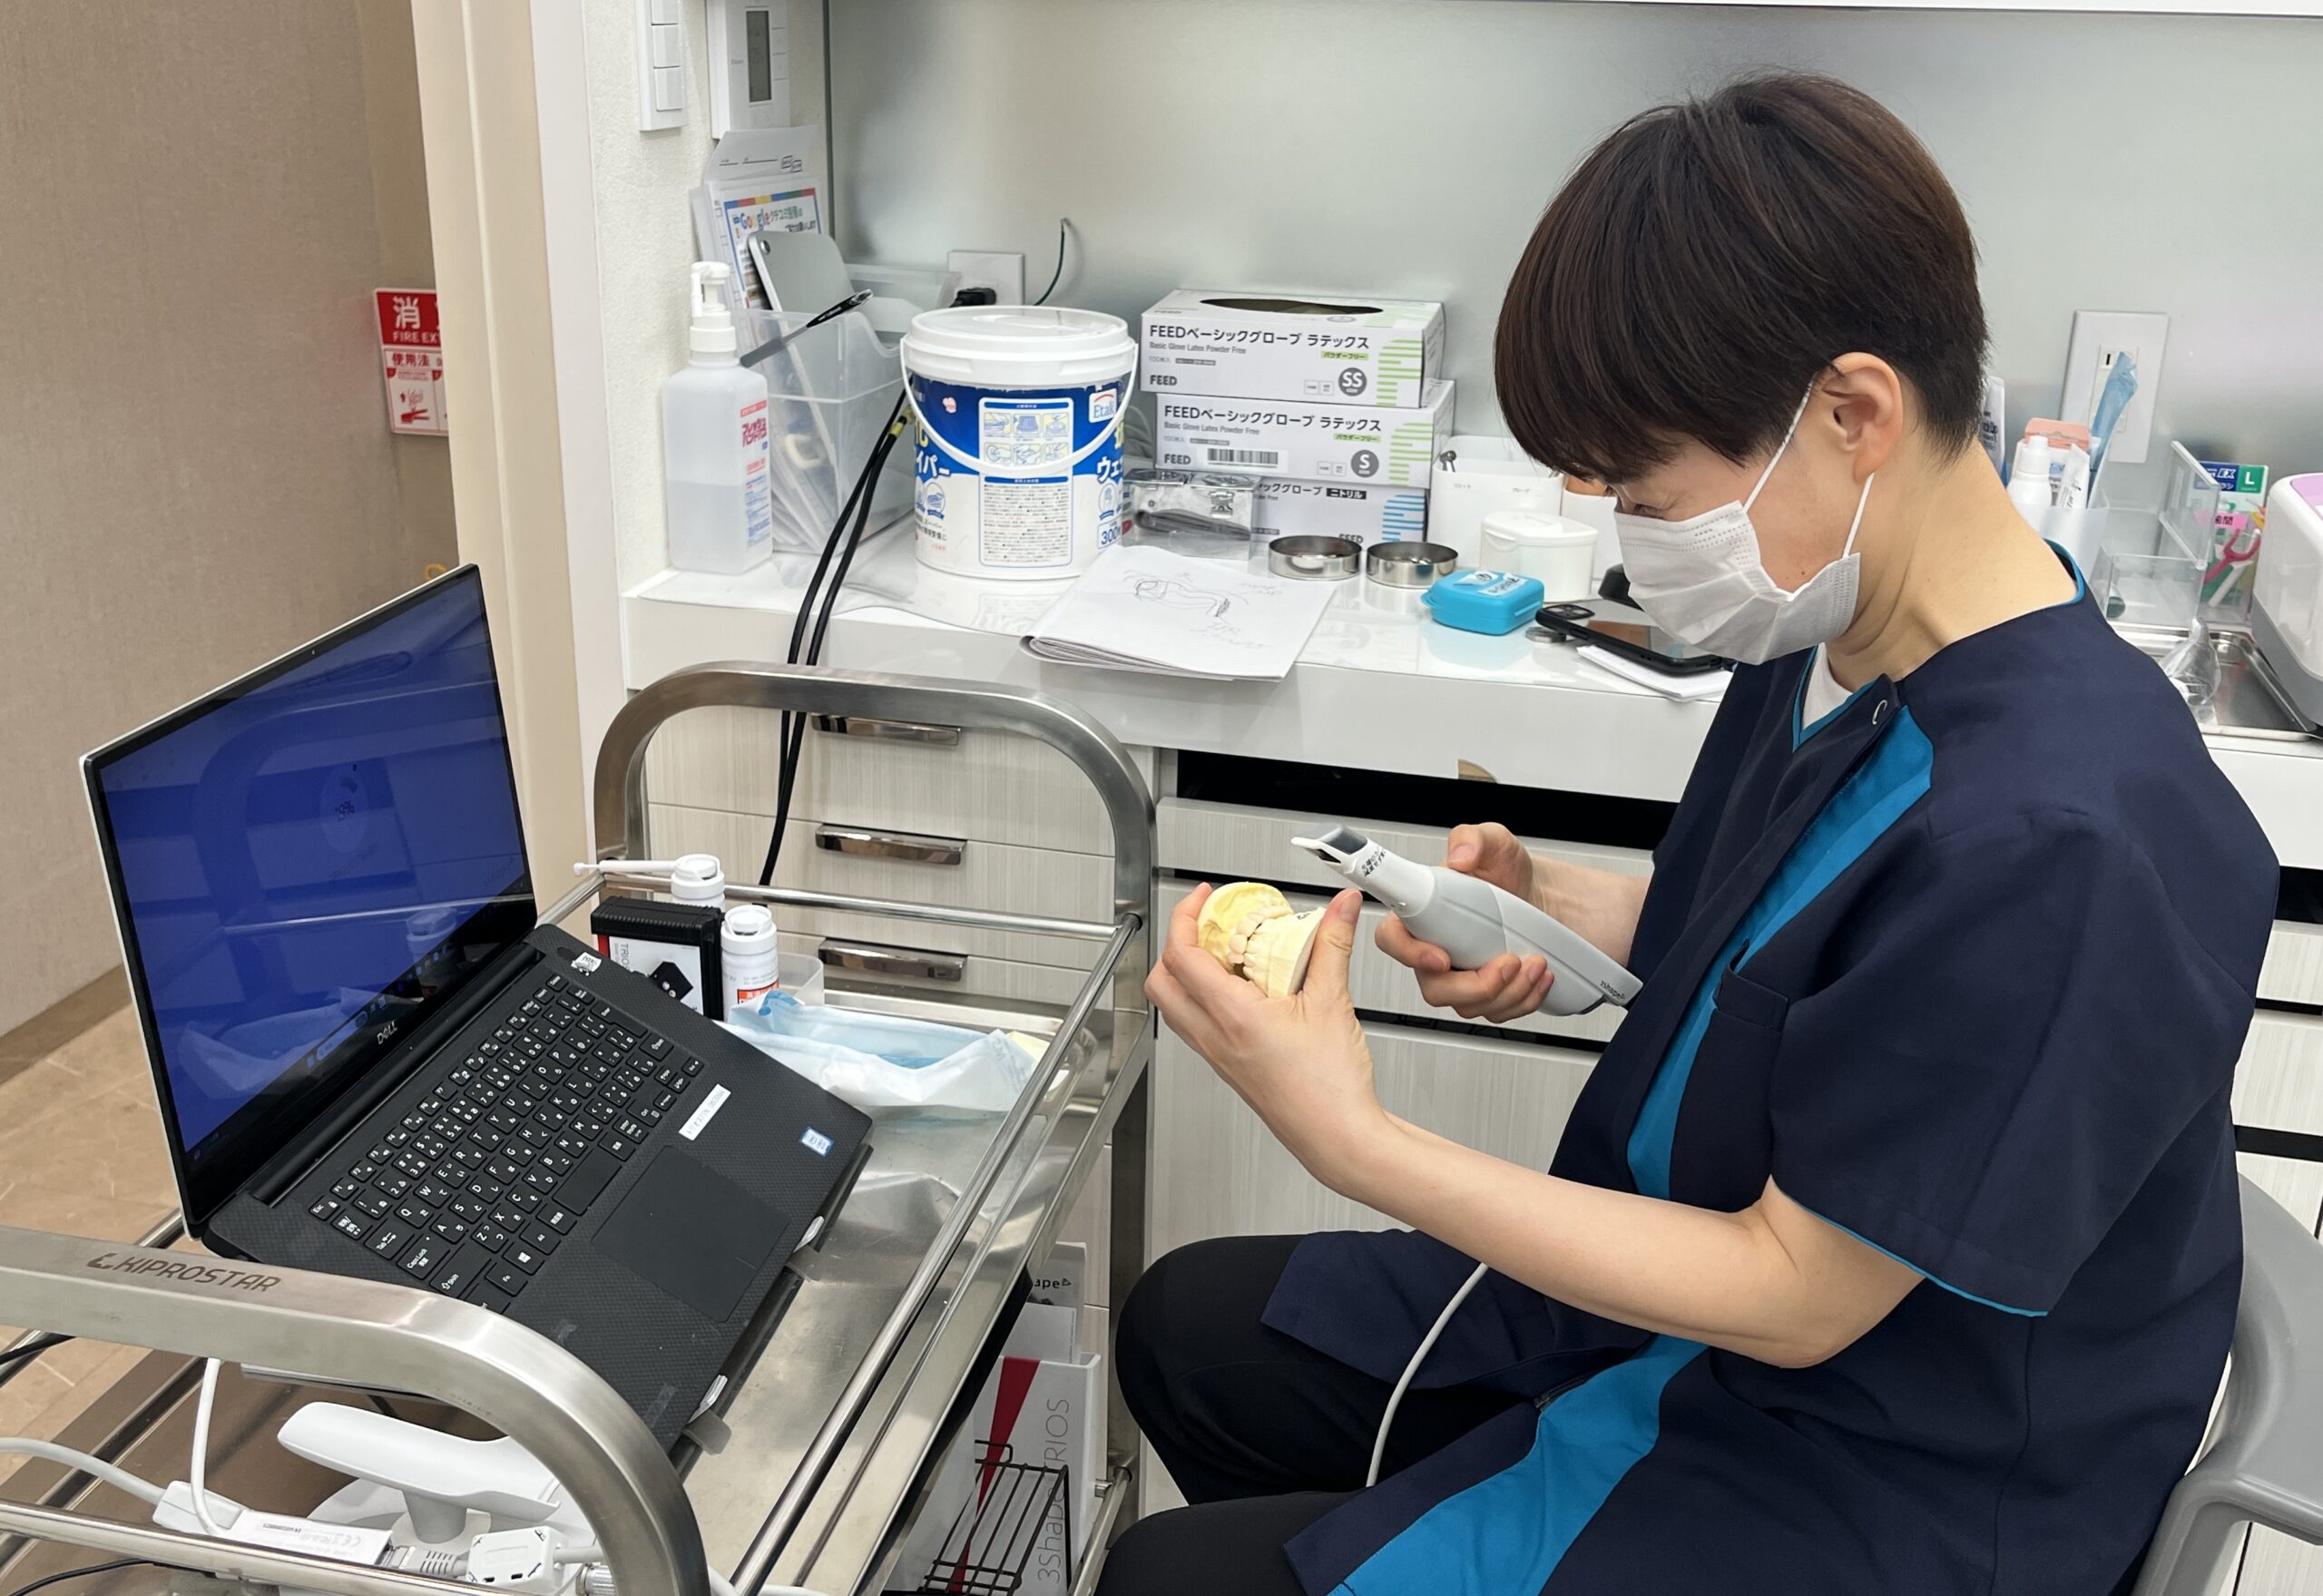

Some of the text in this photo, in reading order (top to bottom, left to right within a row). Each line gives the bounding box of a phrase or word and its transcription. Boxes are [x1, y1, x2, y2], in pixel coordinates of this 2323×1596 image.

[393, 332, 419, 342] FIRE
[1150, 325, 1368, 349] FEEDベーシックグローブ ラテックス
[1169, 343, 1186, 351] Glove
[1206, 345, 1230, 354] Powder
[1231, 347, 1247, 355] Free
[1150, 375, 1178, 387] FEED
[1341, 371, 1363, 388] SS
[1164, 405, 1381, 432] FEEDベーシックグローブ ラテックス
[1220, 426, 1243, 434] Powder
[1245, 427, 1260, 436] Free
[1164, 454, 1191, 465] FEED
[1359, 454, 1370, 469] S
[1095, 455, 1122, 484] ウェ
[2245, 472, 2255, 485] L
[1329, 488, 1364, 499] ニトリル
[377, 1020, 397, 1045] DELL
[505, 1098, 515, 1107] U
[554, 1097, 563, 1105] K
[490, 1115, 500, 1123] Y
[539, 1112, 547, 1121] J
[573, 1121, 584, 1131] M
[473, 1132, 483, 1141] T
[522, 1130, 533, 1139] H
[559, 1139, 570, 1148] N
[455, 1150, 466, 1160] R
[506, 1148, 516, 1156] G
[543, 1157, 554, 1166] B
[437, 1169, 448, 1178] E
[488, 1166, 498, 1175] F
[527, 1174, 537, 1183] V
[419, 1186, 432, 1197] W
[472, 1184, 482, 1193] D
[512, 1193, 522, 1203] C
[400, 1208, 412, 1217] Q
[455, 1203, 465, 1212] S
[495, 1212, 505, 1222] X
[437, 1224, 447, 1233] A
[476, 1232, 487, 1242] Z
[113, 1255, 281, 1292] KIPROSTAR
[1044, 1398, 1070, 1468] RIOS
